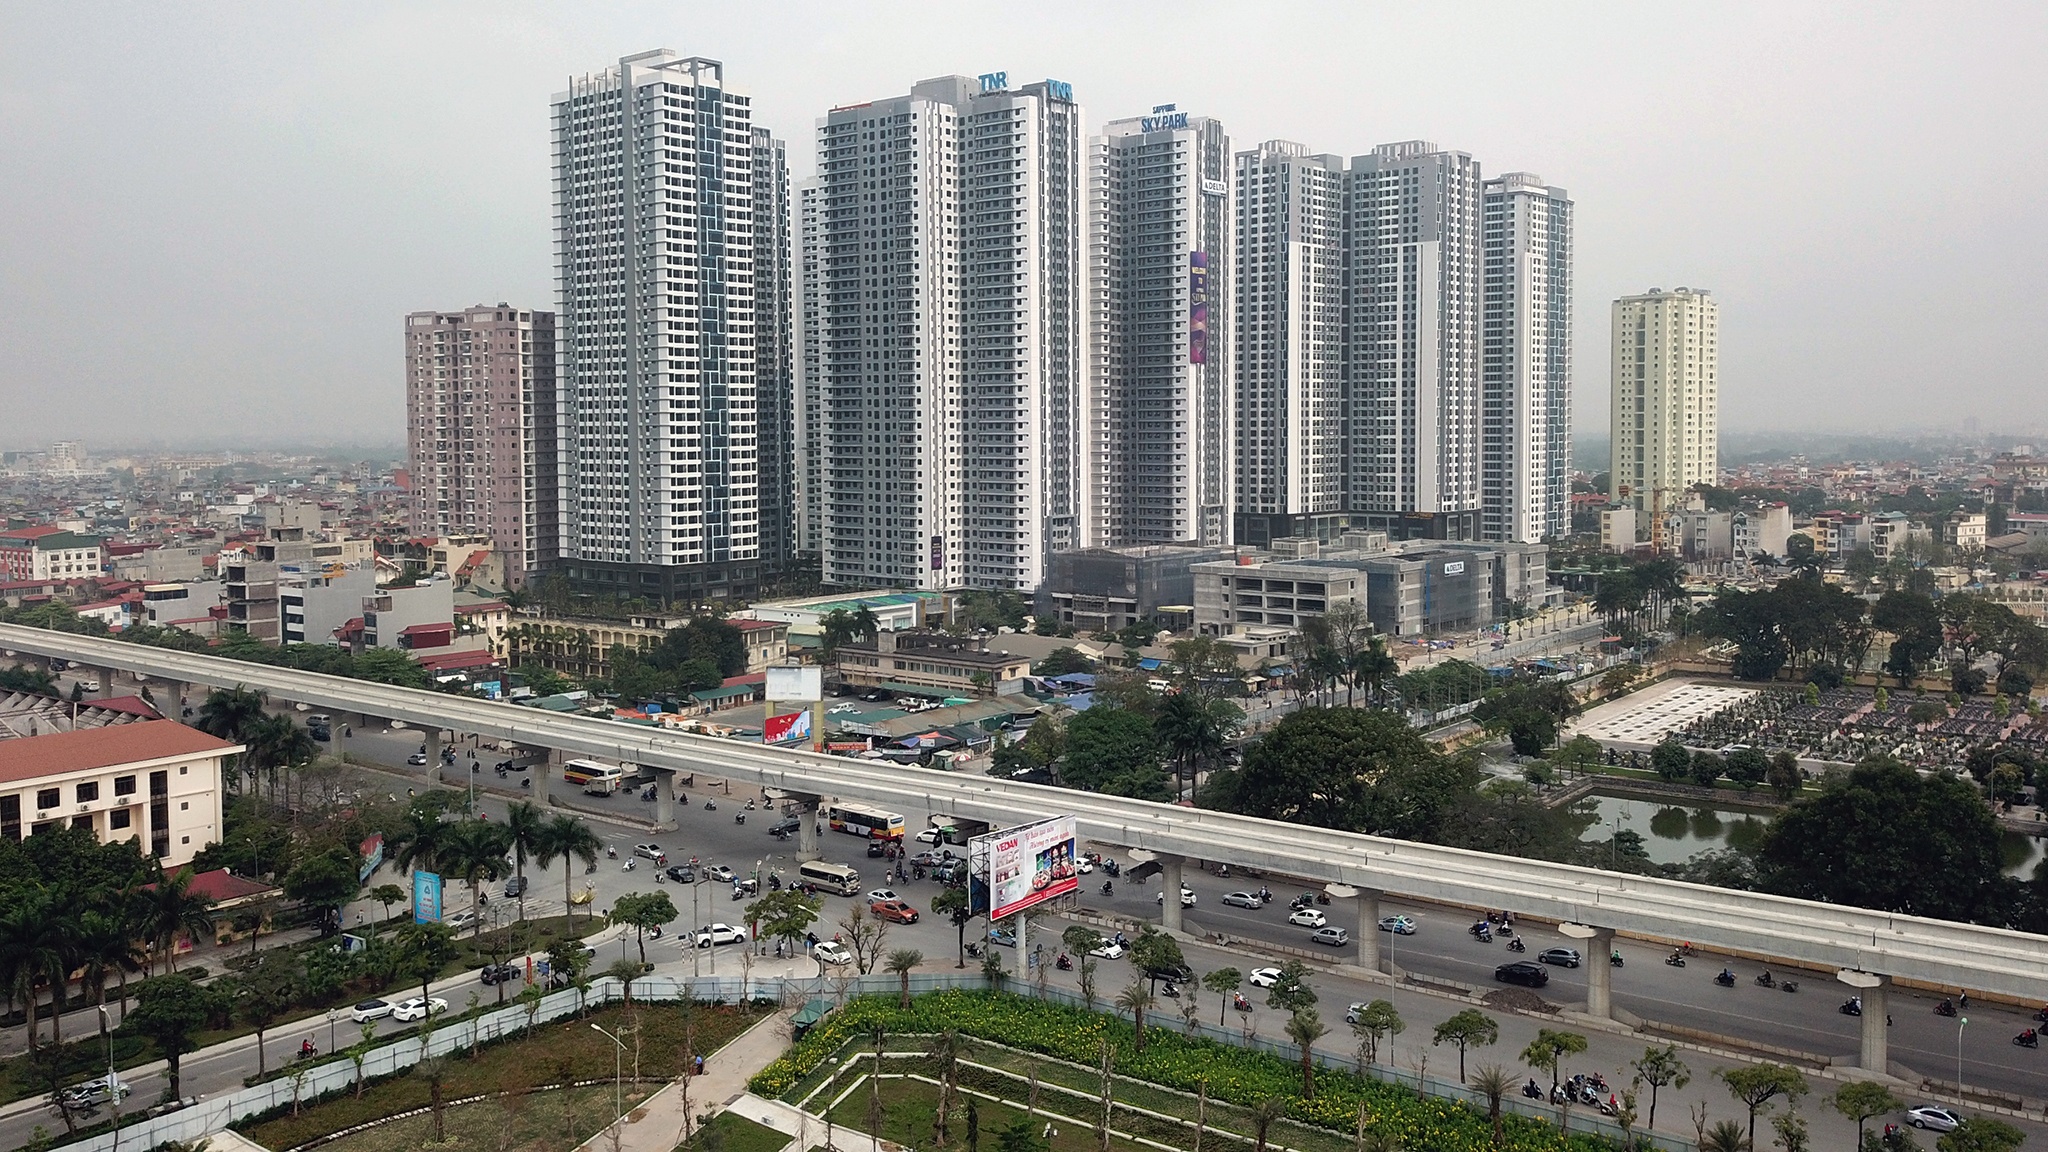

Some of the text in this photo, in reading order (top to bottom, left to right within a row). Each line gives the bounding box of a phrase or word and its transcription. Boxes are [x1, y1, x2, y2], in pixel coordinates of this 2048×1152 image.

[978, 71, 1007, 92] TNR
[1046, 78, 1073, 101] TNR
[1141, 112, 1188, 133] SKY PARK
[1208, 182, 1225, 192] DELTA
[996, 838, 1018, 853] VEDAN
